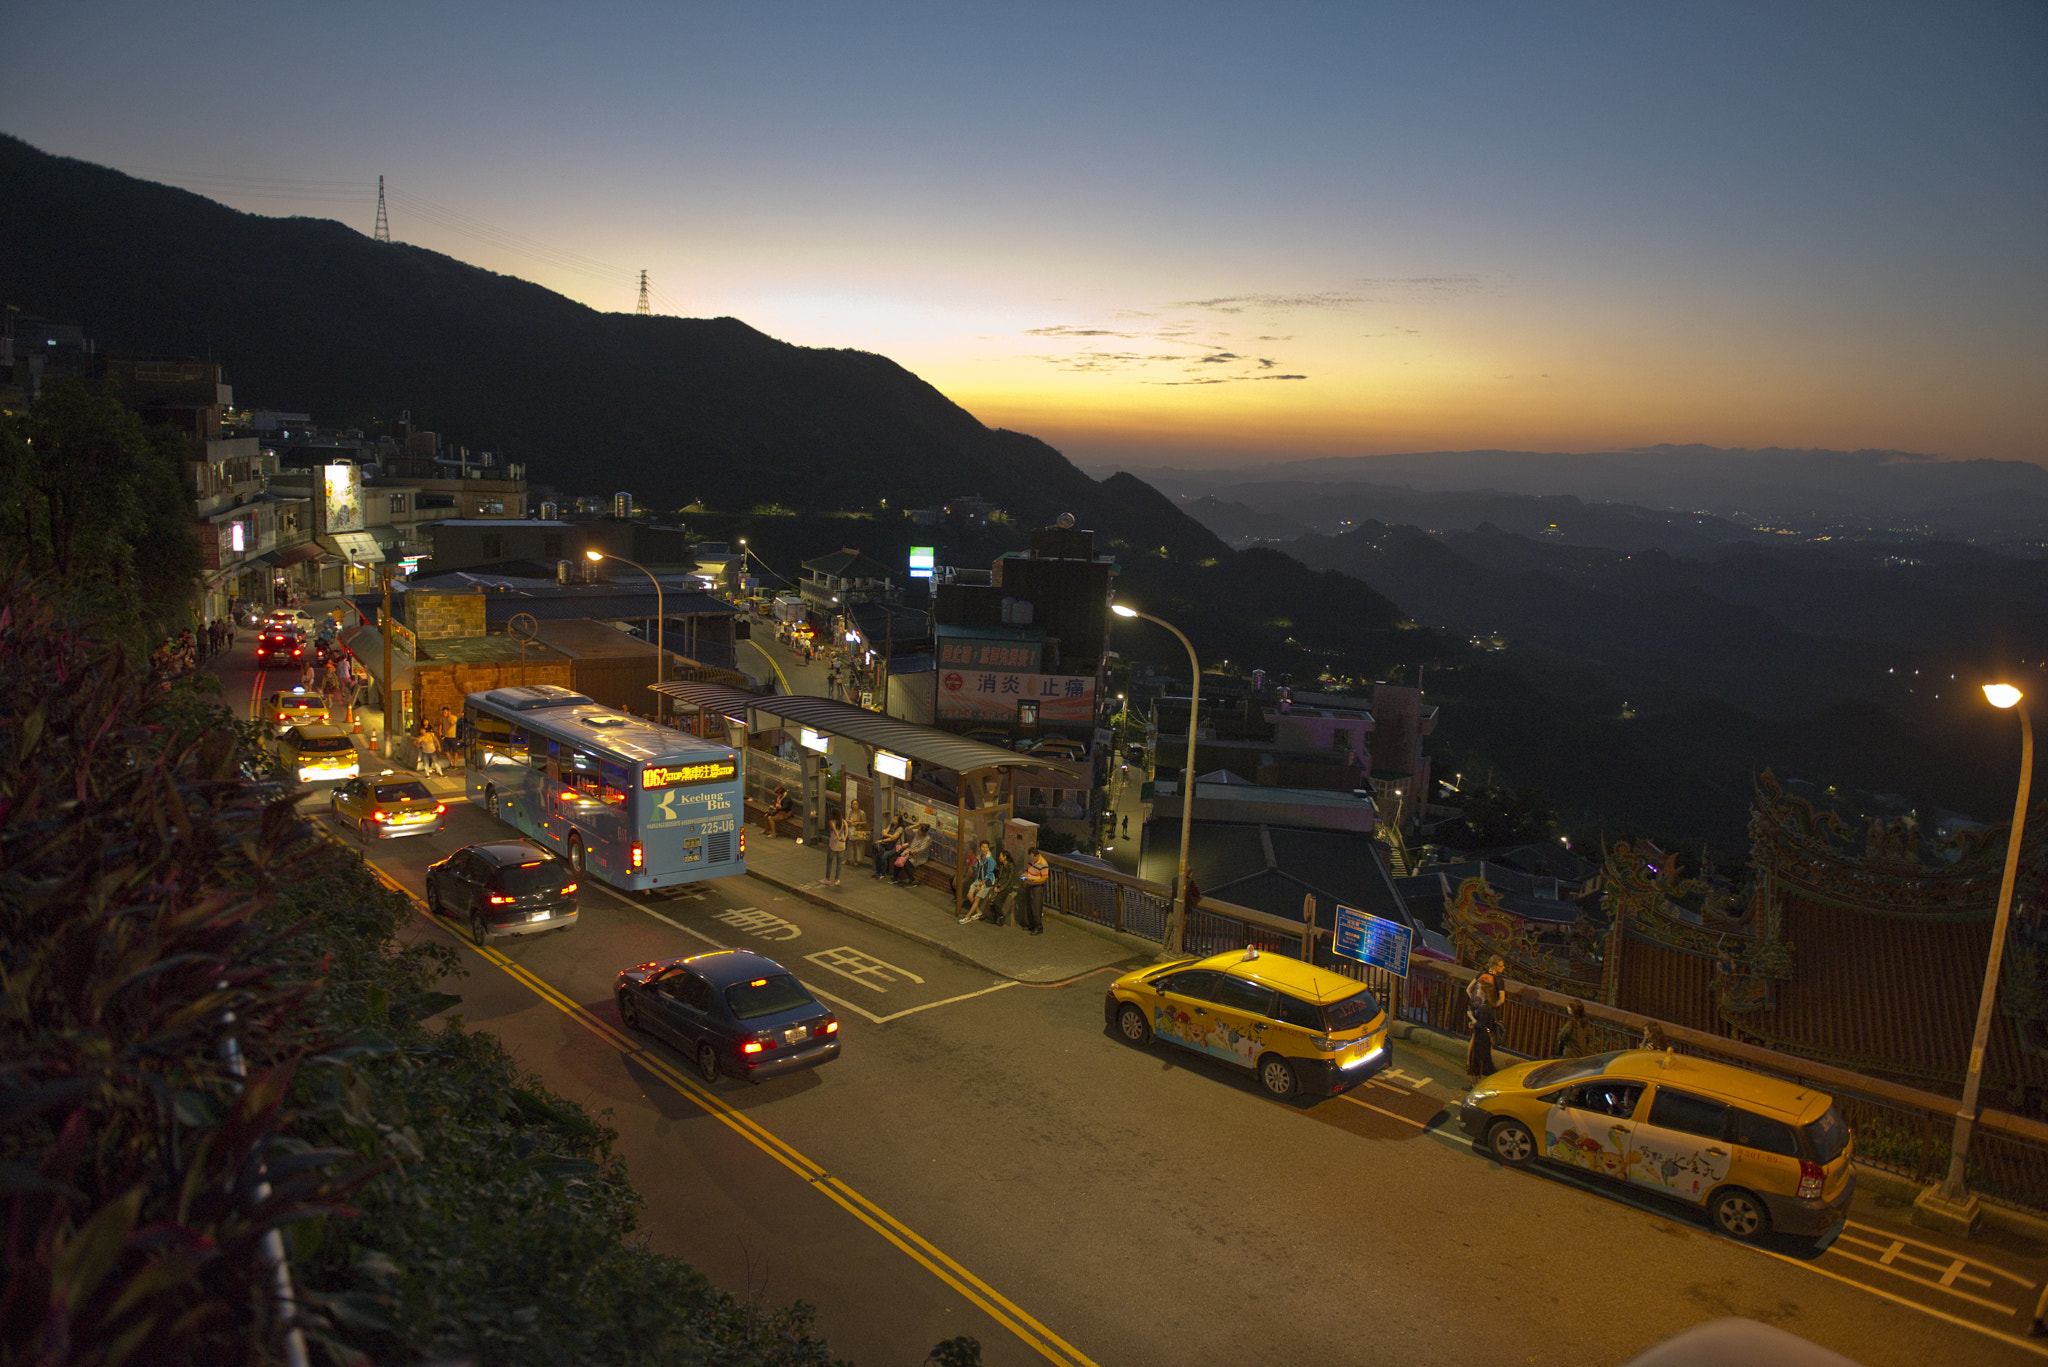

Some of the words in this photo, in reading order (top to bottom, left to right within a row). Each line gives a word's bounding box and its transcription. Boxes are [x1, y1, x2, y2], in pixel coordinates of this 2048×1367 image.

[977, 673, 1020, 695] 消炎
[1040, 677, 1085, 698] 止痛
[643, 768, 668, 788] 1062
[681, 793, 724, 804] Keelung
[707, 799, 731, 811] Bus
[701, 819, 735, 835] 225-U6
